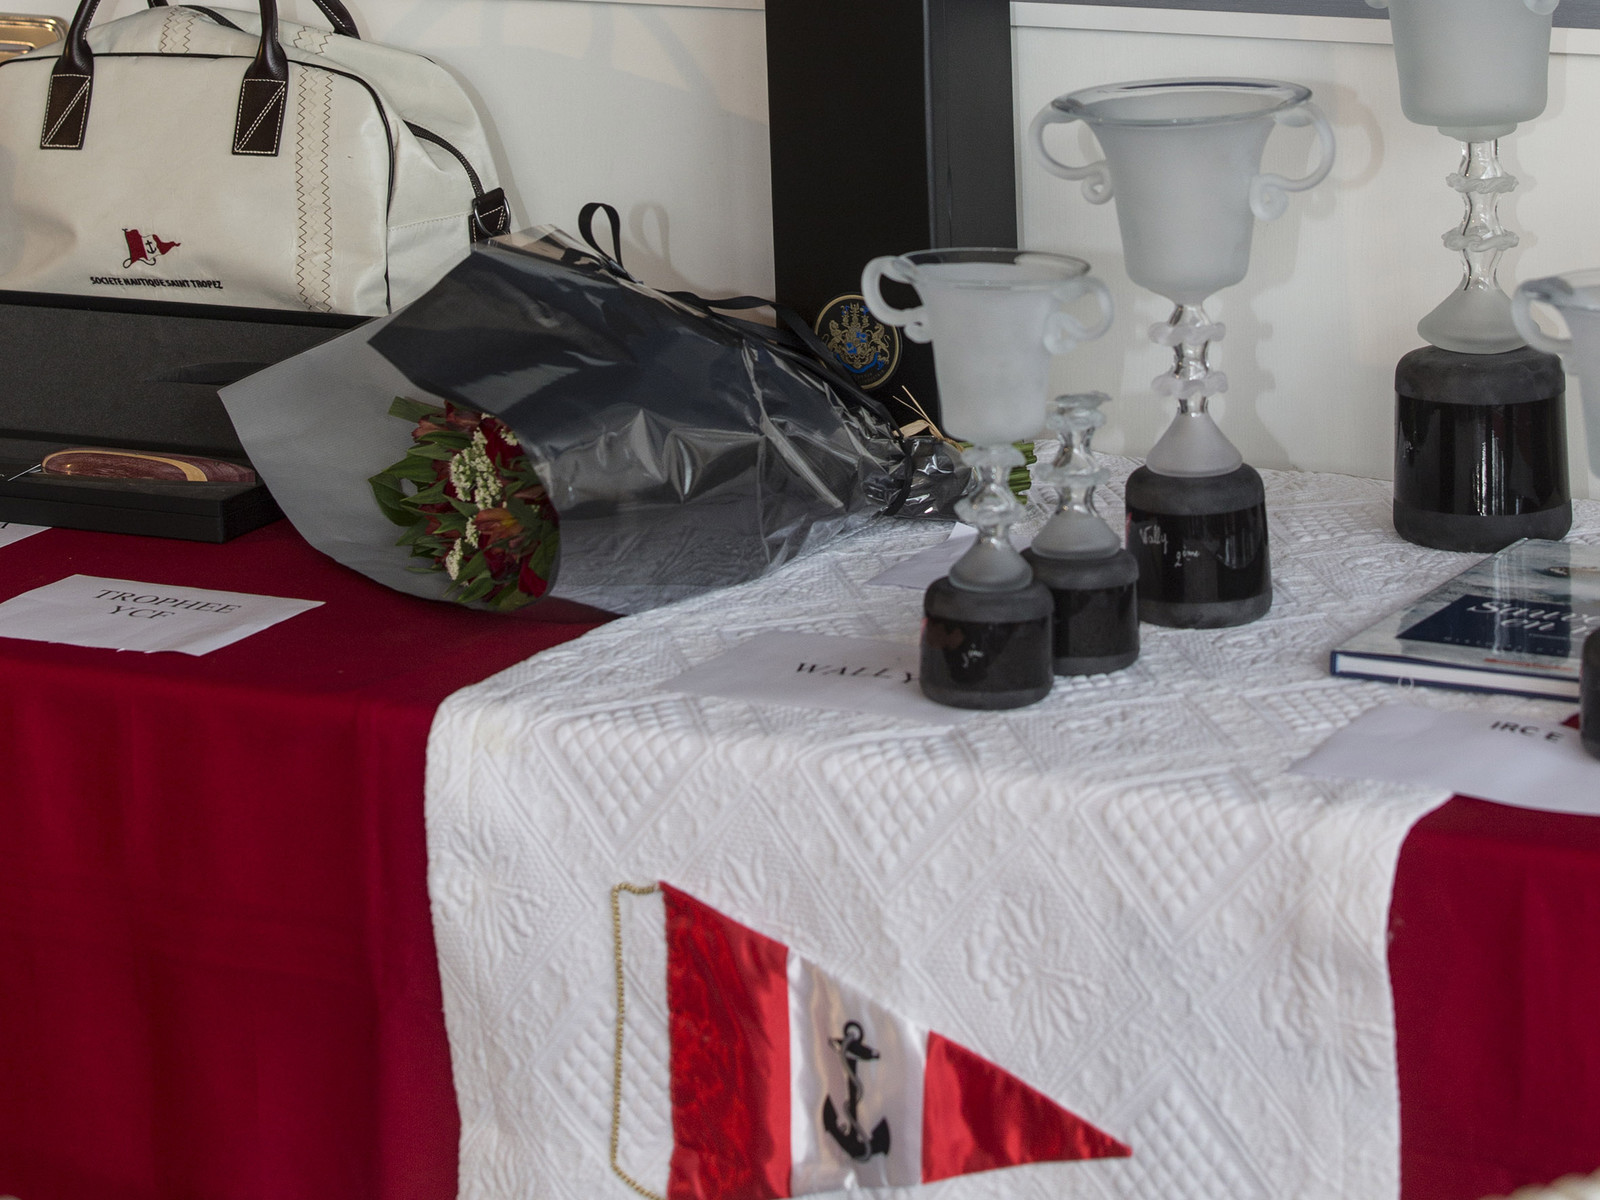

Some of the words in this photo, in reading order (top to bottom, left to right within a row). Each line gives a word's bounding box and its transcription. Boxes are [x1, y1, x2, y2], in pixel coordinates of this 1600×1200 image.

[90, 276, 122, 285] SOCIETE
[122, 278, 166, 287] NAUTIQUE
[166, 279, 190, 288] SAINT
[190, 280, 223, 289] TROPEZ
[93, 588, 242, 616] TROPHEE
[107, 605, 176, 620] YCF
[796, 662, 920, 684] WALLY
[1490, 720, 1540, 737] IRC
[1545, 730, 1565, 743] E
